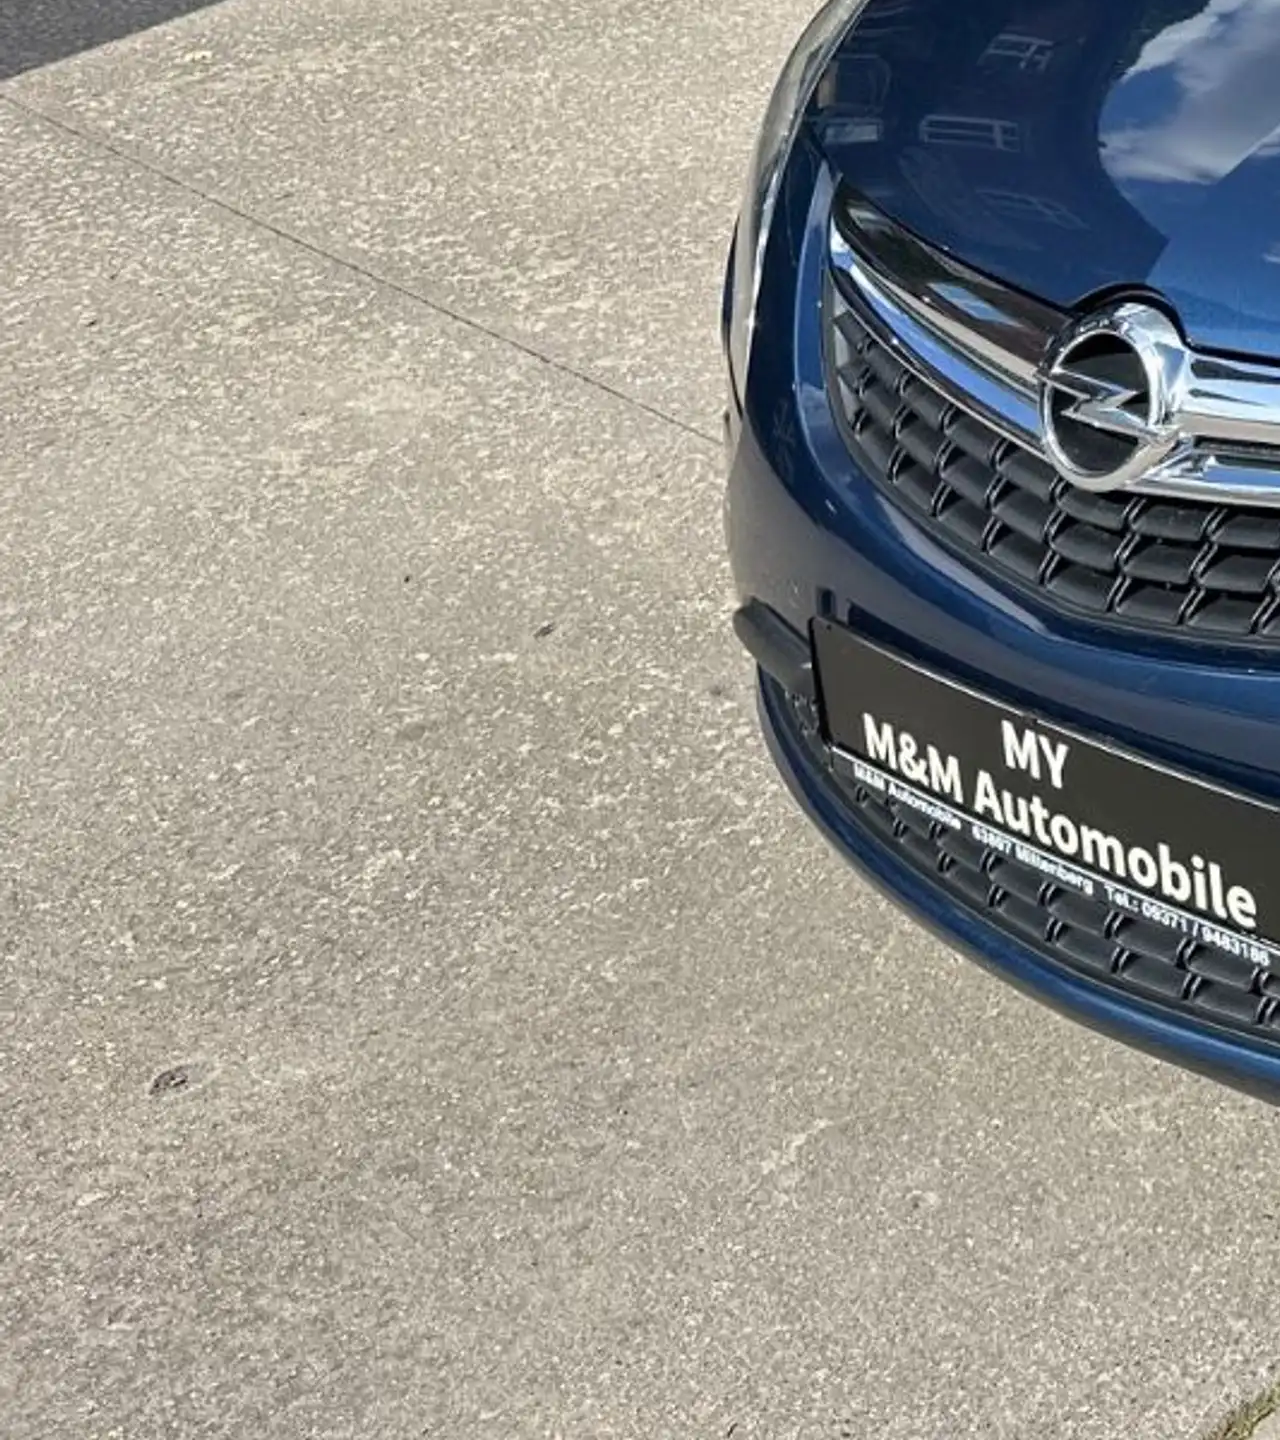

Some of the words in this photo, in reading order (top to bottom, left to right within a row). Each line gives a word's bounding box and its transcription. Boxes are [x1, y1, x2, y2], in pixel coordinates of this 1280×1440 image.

[1001, 719, 1069, 789] MY
[862, 712, 963, 805] M&M
[973, 768, 1258, 929] Automobile
[888, 782, 961, 829] Automobile
[1015, 843, 1094, 895] Miltenberg
